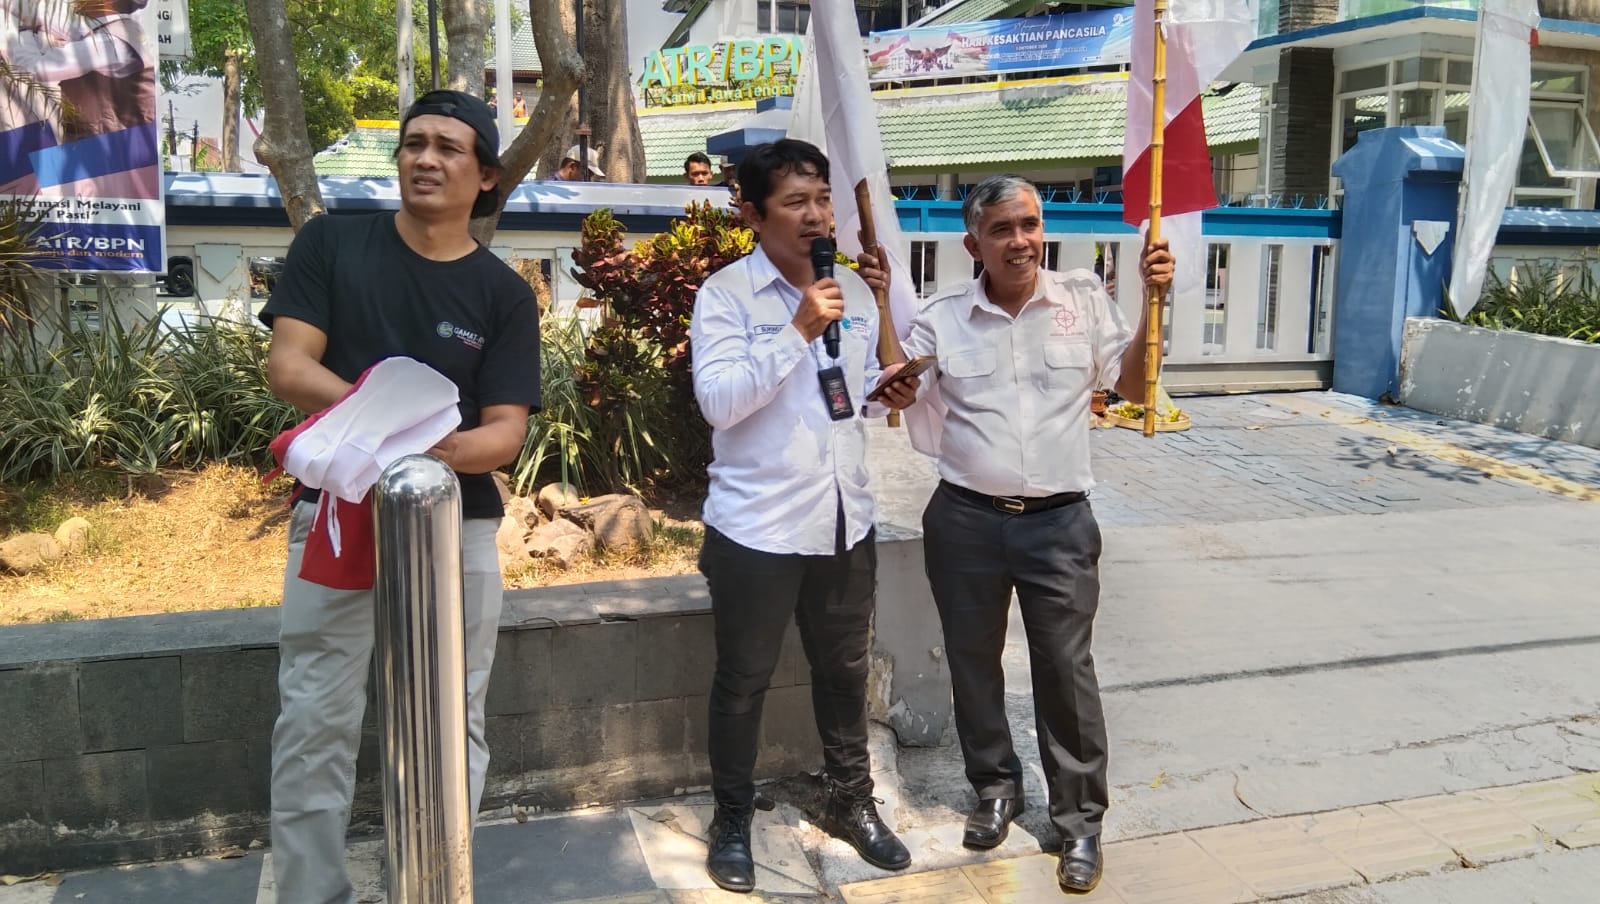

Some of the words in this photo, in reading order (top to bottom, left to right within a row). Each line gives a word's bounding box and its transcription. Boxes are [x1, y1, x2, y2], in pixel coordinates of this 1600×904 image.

[961, 36, 985, 48] HARI
[987, 31, 1044, 46] KESAKTIAN
[1046, 25, 1106, 40] PANCASILA
[708, 88, 742, 102] Jawa
[744, 82, 797, 99] Tengah
[77, 200, 141, 211] Melayani
[36, 235, 145, 250] ATR/BPN
[68, 249, 92, 257] dan
[95, 251, 144, 259] modern
